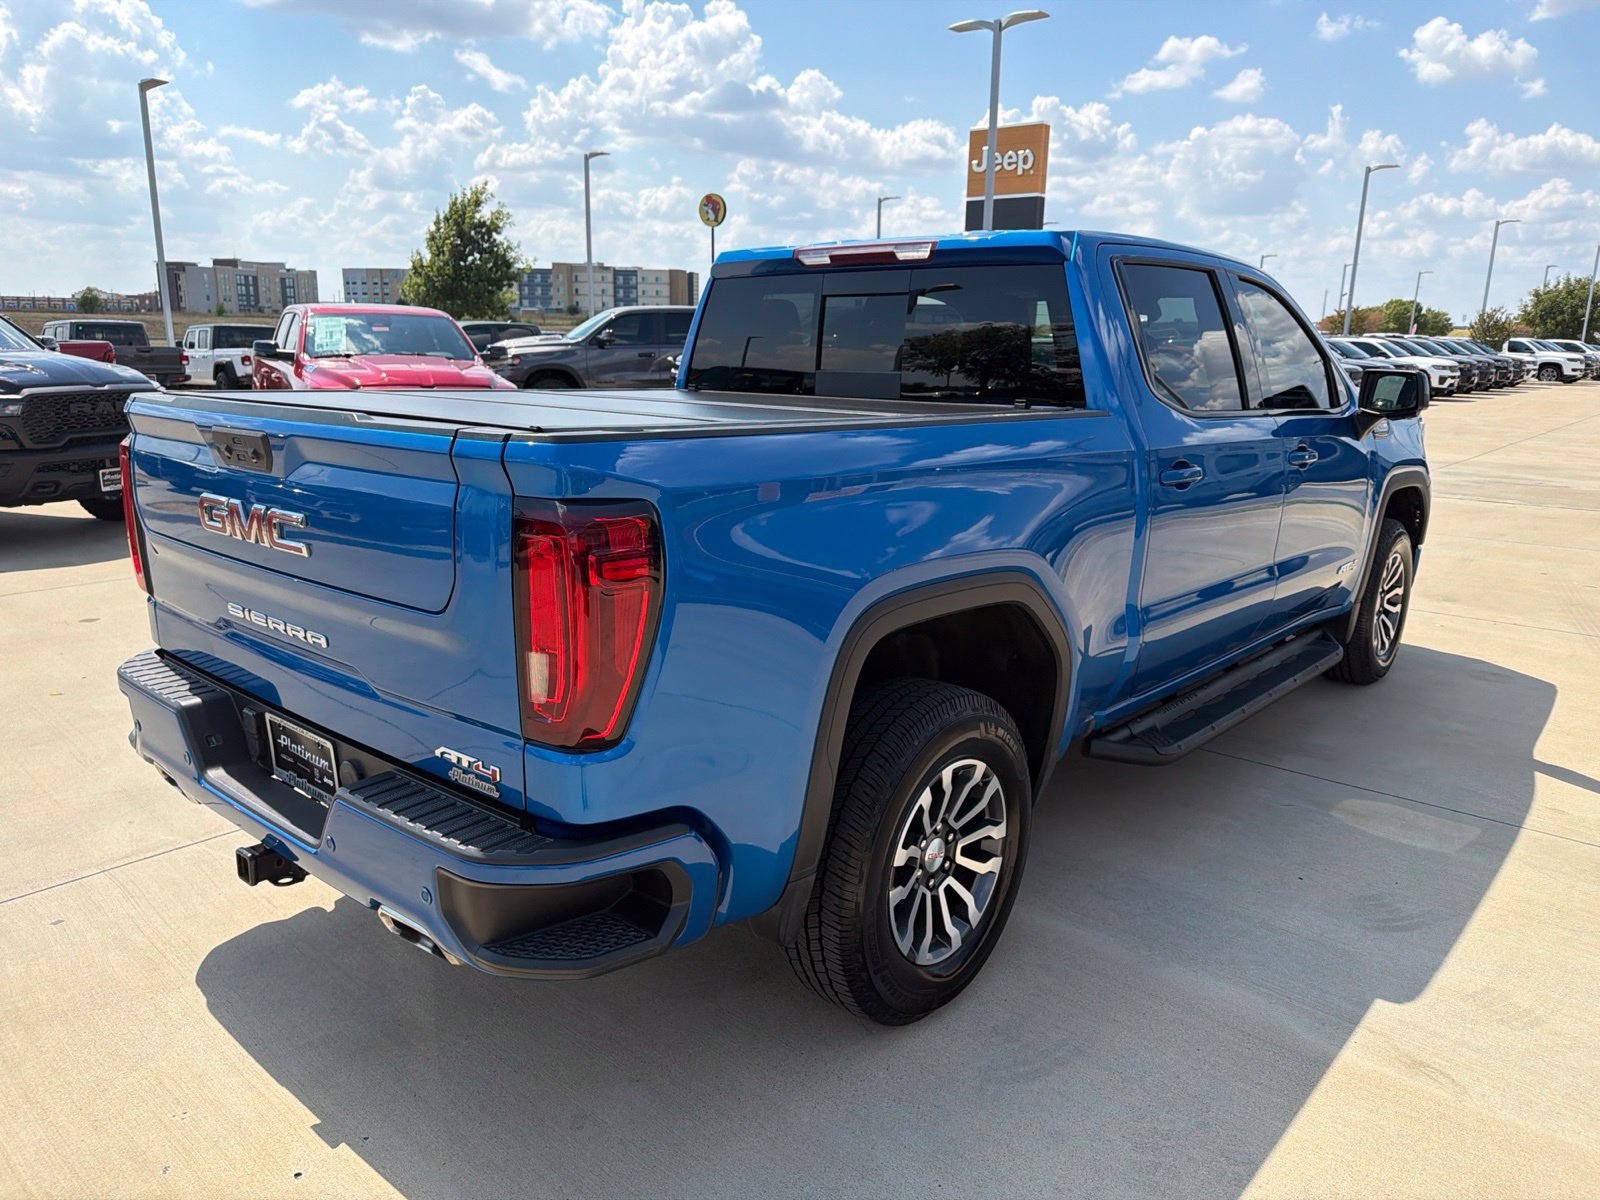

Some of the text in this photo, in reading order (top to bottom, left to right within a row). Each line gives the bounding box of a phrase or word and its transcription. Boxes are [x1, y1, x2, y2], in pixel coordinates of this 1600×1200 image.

[971, 145, 1035, 176] Jeep
[198, 492, 311, 558] GMC
[227, 602, 329, 649] SIERRA
[277, 734, 333, 773] Platinum
[434, 746, 501, 782] AT4
[448, 766, 500, 798] Platinum
